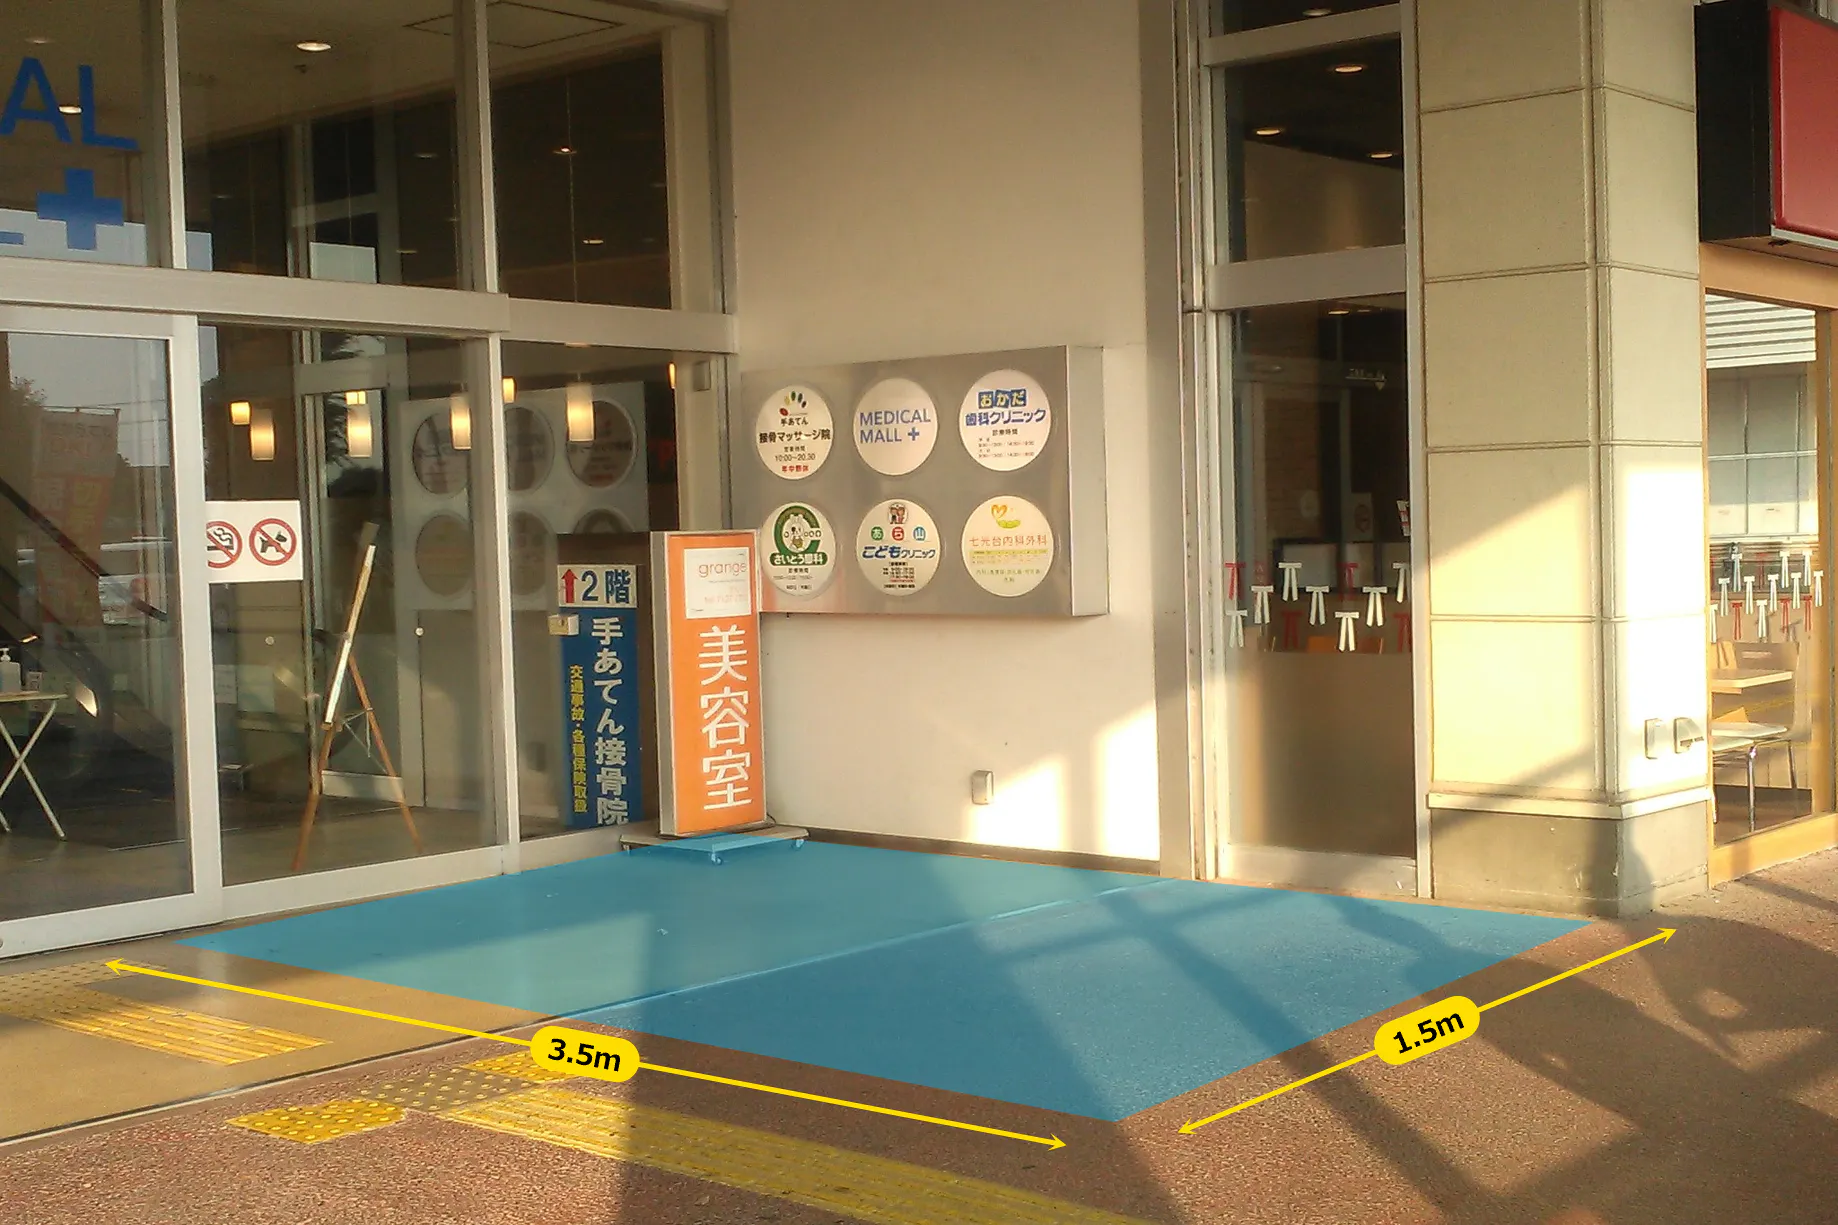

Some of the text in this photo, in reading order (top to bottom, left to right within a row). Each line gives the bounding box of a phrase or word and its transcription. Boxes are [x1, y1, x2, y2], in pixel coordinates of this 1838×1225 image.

[979, 389, 1026, 408] おかだ
[860, 408, 931, 426] MEDICAL
[965, 409, 1046, 426] 歯科クリニック
[860, 428, 902, 443] MALL
[862, 545, 936, 559] こどもクリニック
[581, 569, 631, 604] 2階
[591, 616, 629, 825] 手あてん接骨院
[698, 624, 752, 811] 美容室
